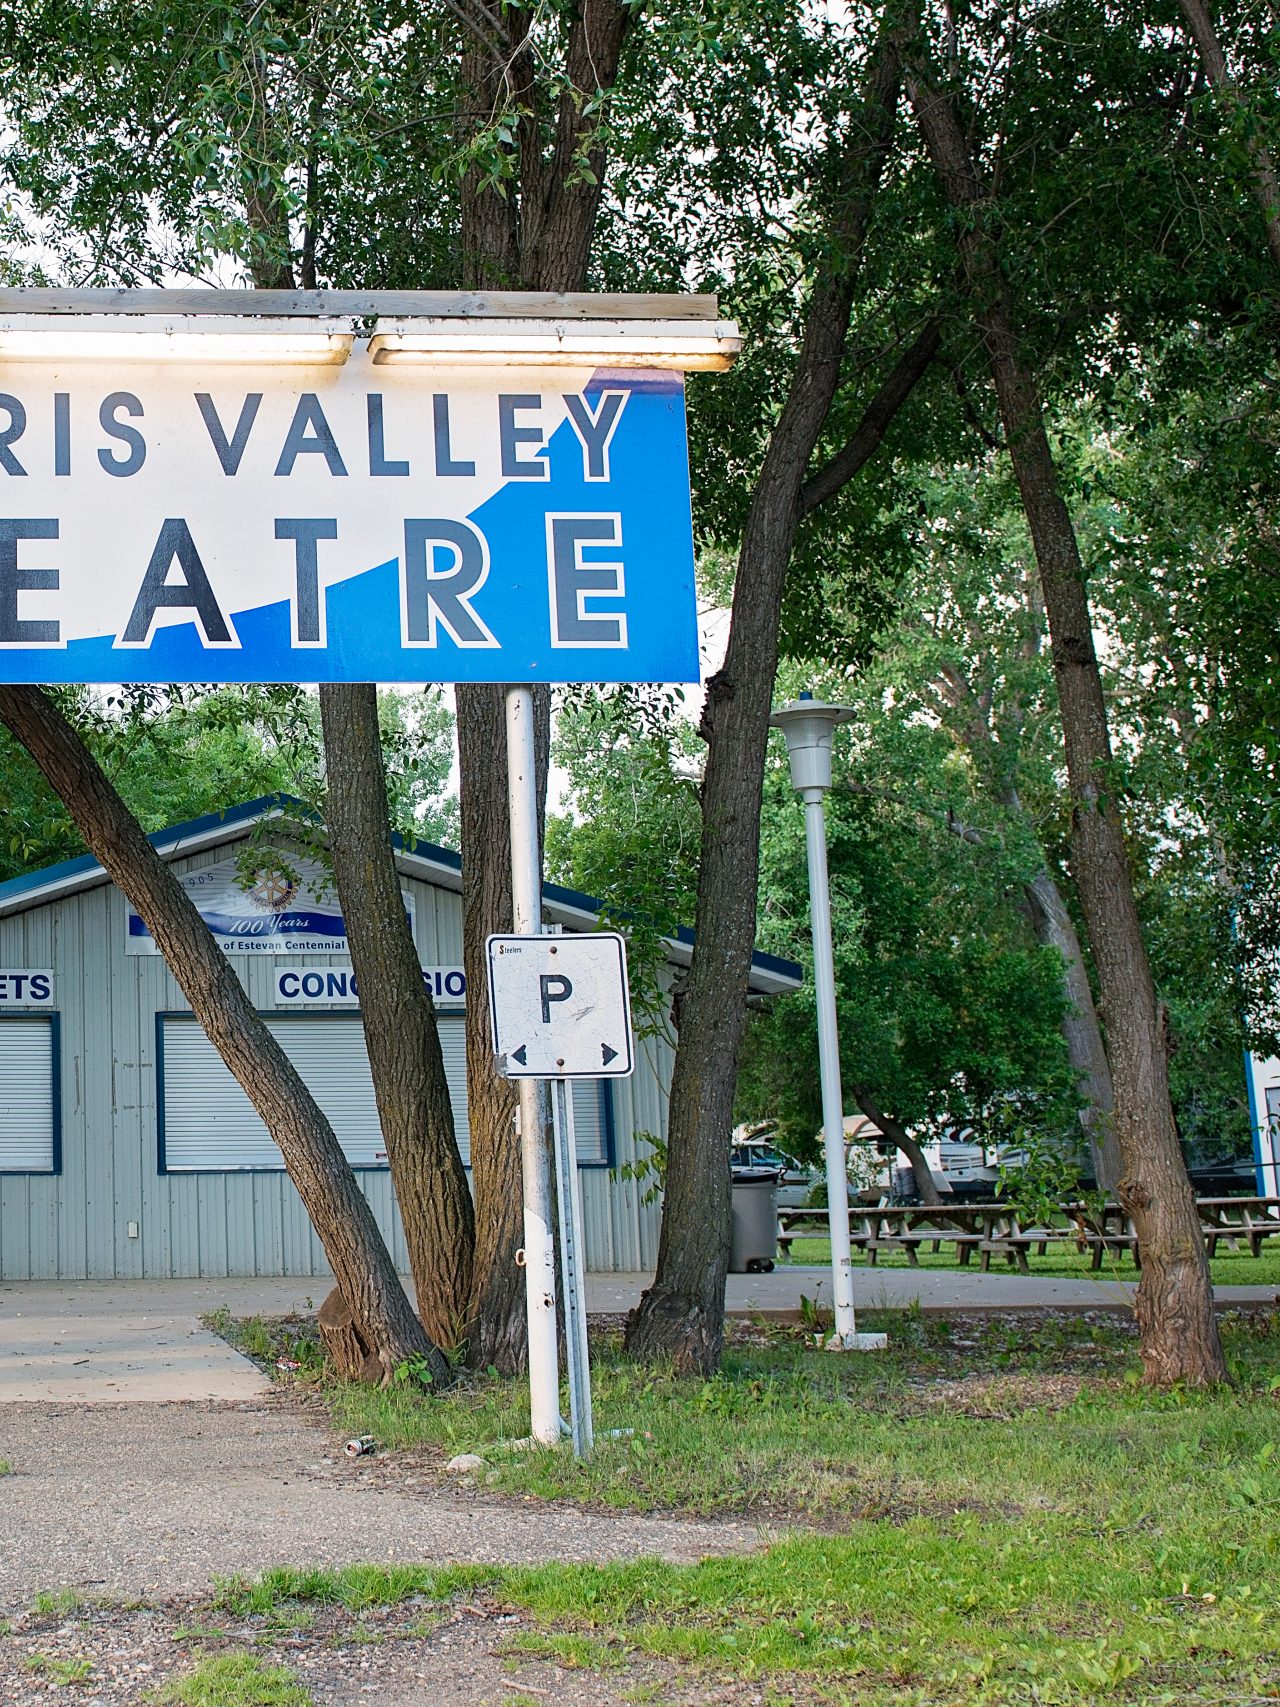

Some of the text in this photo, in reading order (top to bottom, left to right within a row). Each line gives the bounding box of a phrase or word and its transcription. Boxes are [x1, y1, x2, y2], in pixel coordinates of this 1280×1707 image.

[193, 391, 629, 479] VALLEY
[228, 913, 310, 935] 100 Years
[223, 940, 345, 950] of Estevan Centennial
[539, 974, 573, 1023] P
